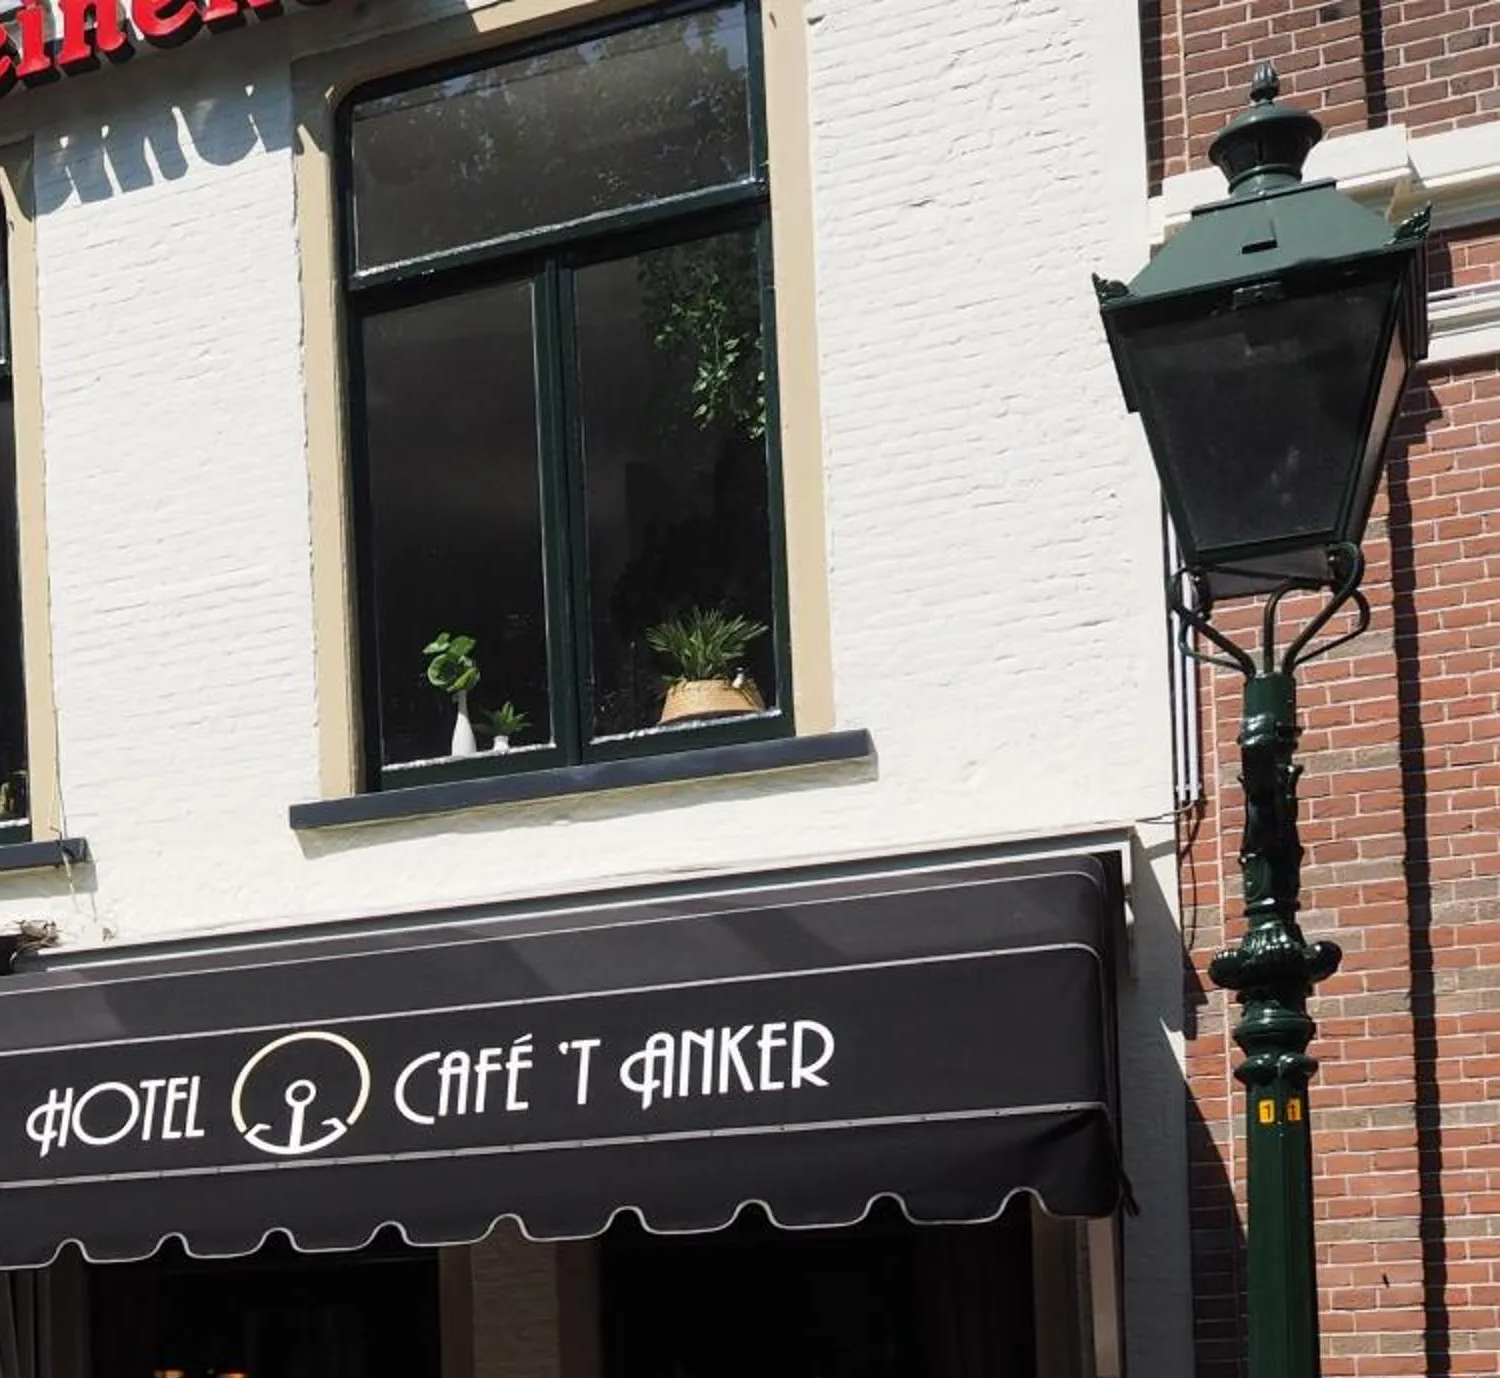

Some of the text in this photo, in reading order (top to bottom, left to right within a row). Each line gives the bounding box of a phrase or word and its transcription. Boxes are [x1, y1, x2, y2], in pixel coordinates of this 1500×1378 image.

[25, 1075, 205, 1159] HOTEL
[394, 1032, 534, 1125] CAFÉ
[618, 1019, 836, 1111] ANKER
